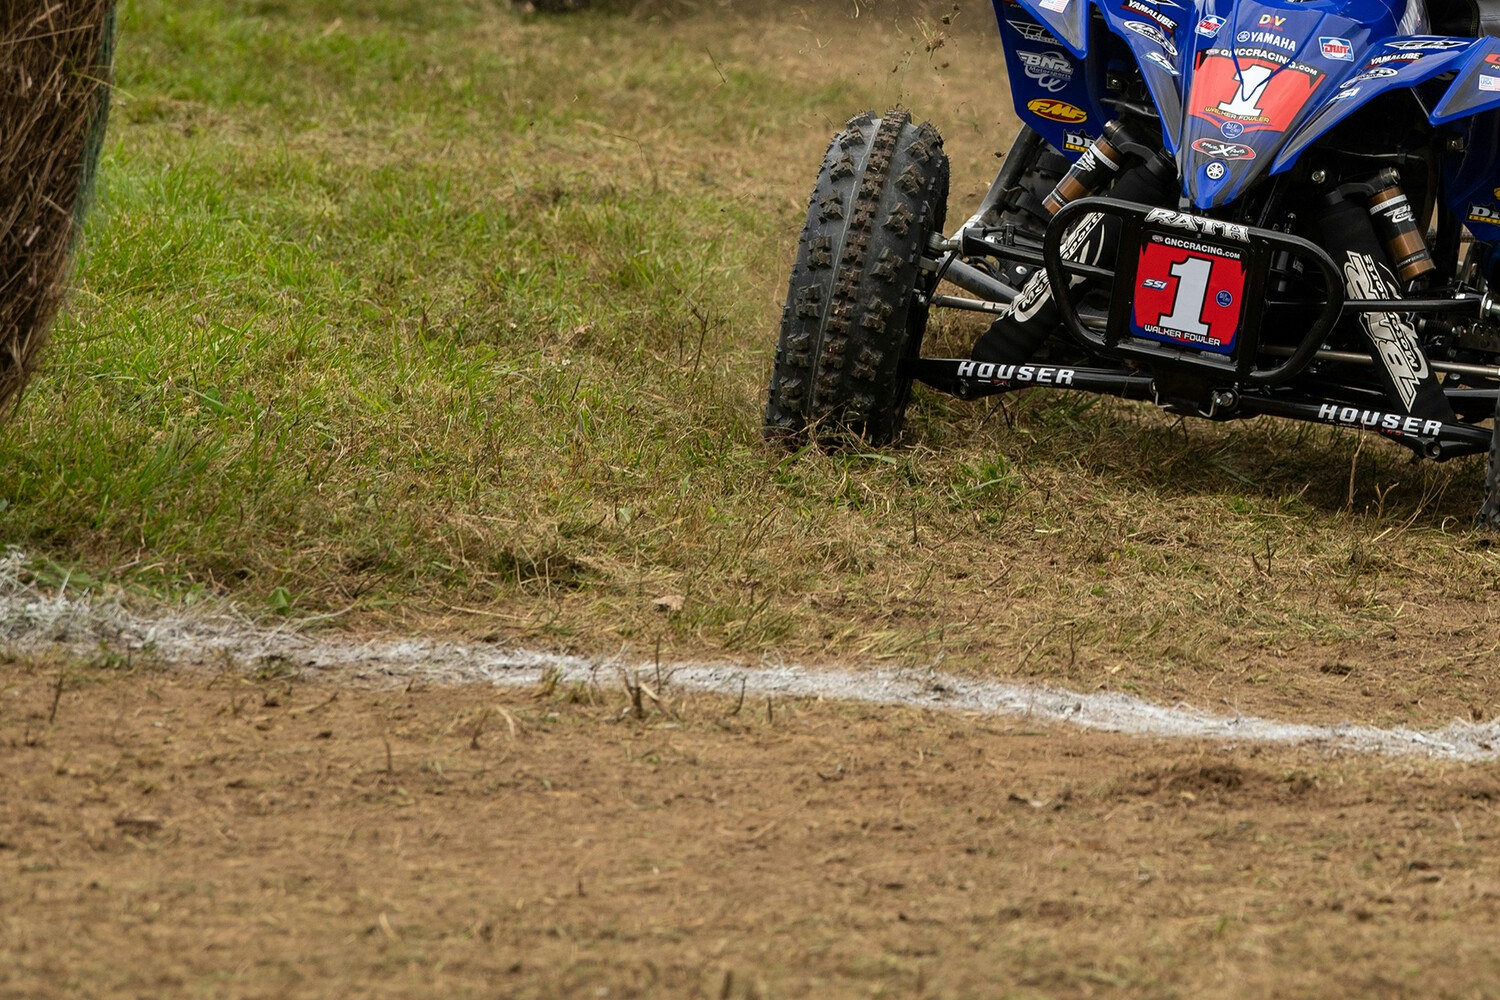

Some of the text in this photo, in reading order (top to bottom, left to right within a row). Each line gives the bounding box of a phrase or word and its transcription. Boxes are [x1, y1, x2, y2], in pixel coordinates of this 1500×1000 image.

[1128, 0, 1176, 30] YAMALUBE
[1251, 32, 1297, 52] YAMAHA
[1022, 53, 1073, 74] BNR
[1369, 53, 1423, 66] YAMALUBE
[1218, 63, 1275, 118] 1
[1028, 100, 1088, 120] FMF
[1144, 207, 1250, 244] RATH
[1164, 236, 1241, 260] GNCCRACING.COM
[1143, 279, 1168, 291] SSI
[1158, 256, 1213, 336] 1
[1144, 324, 1221, 348] WALKER FOWLER
[957, 360, 1075, 387] HOUSER
[1317, 401, 1443, 437] HOUSER
